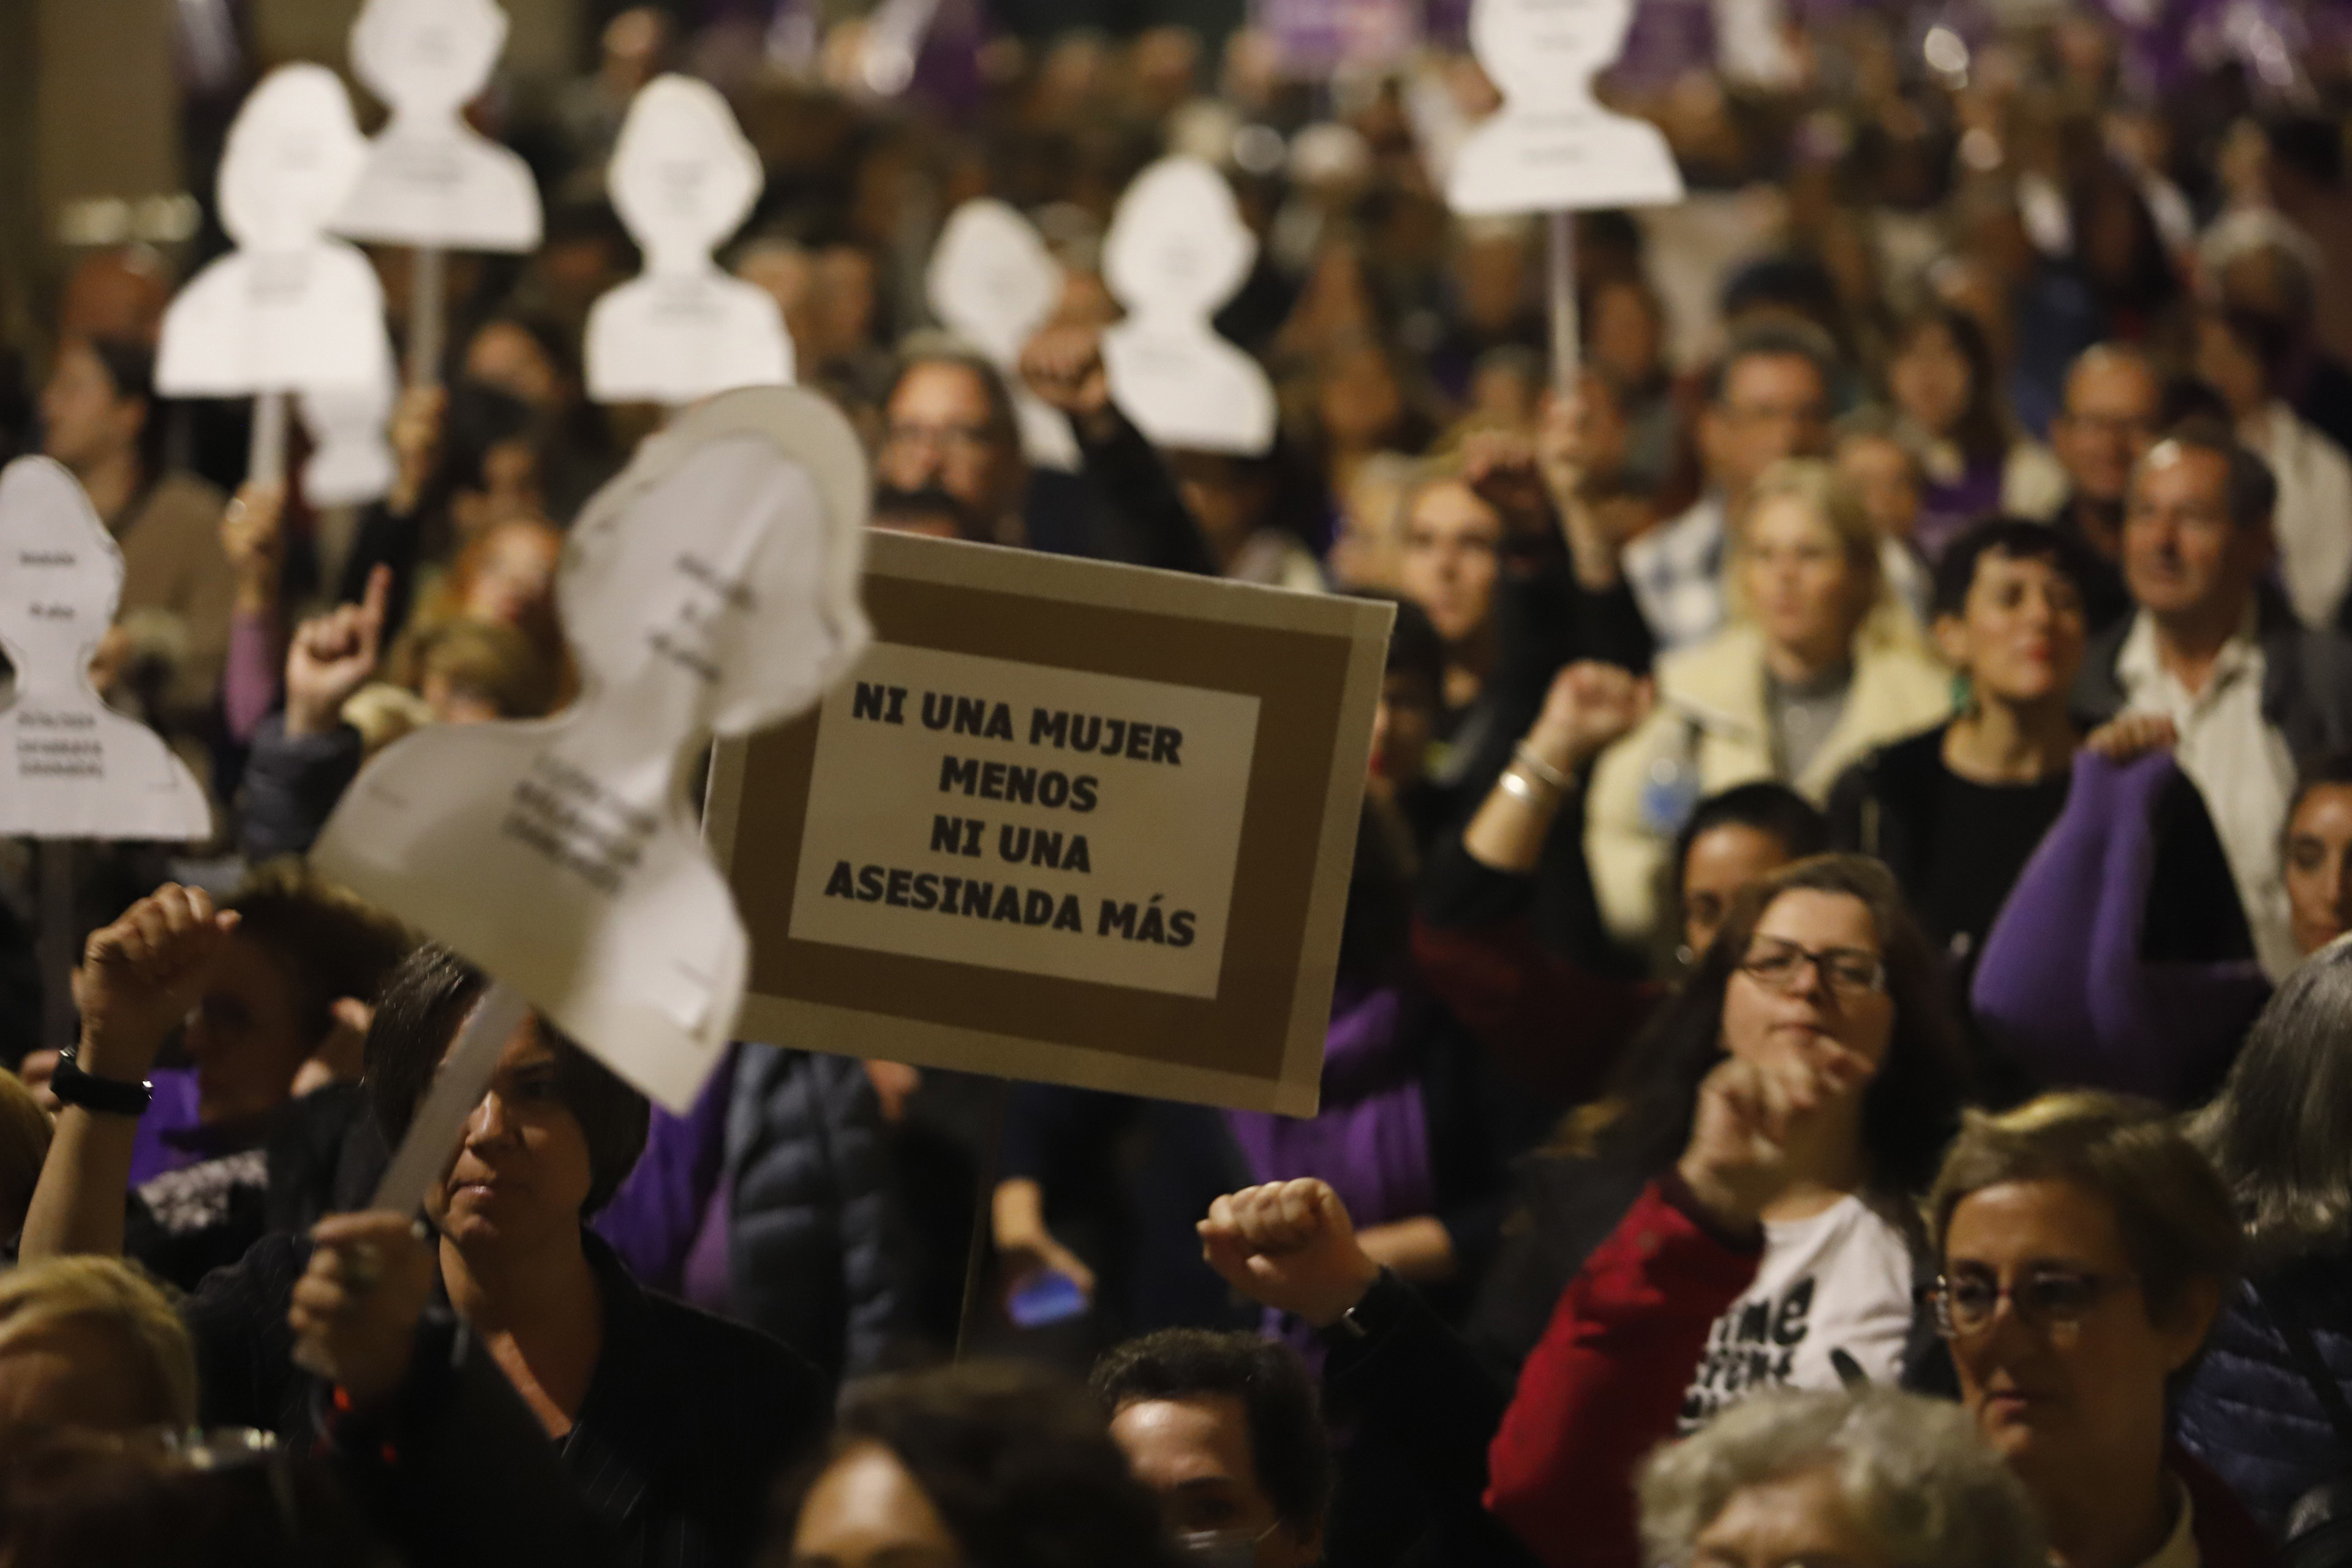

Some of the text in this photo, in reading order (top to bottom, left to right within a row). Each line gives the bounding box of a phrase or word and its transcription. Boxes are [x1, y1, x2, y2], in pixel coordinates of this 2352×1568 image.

[851, 681, 1183, 766] NI UNA MUJER
[938, 754, 1099, 814] MENOS
[929, 813, 1091, 875] NI UNA
[823, 859, 1197, 949] ASESINADA MÁS
